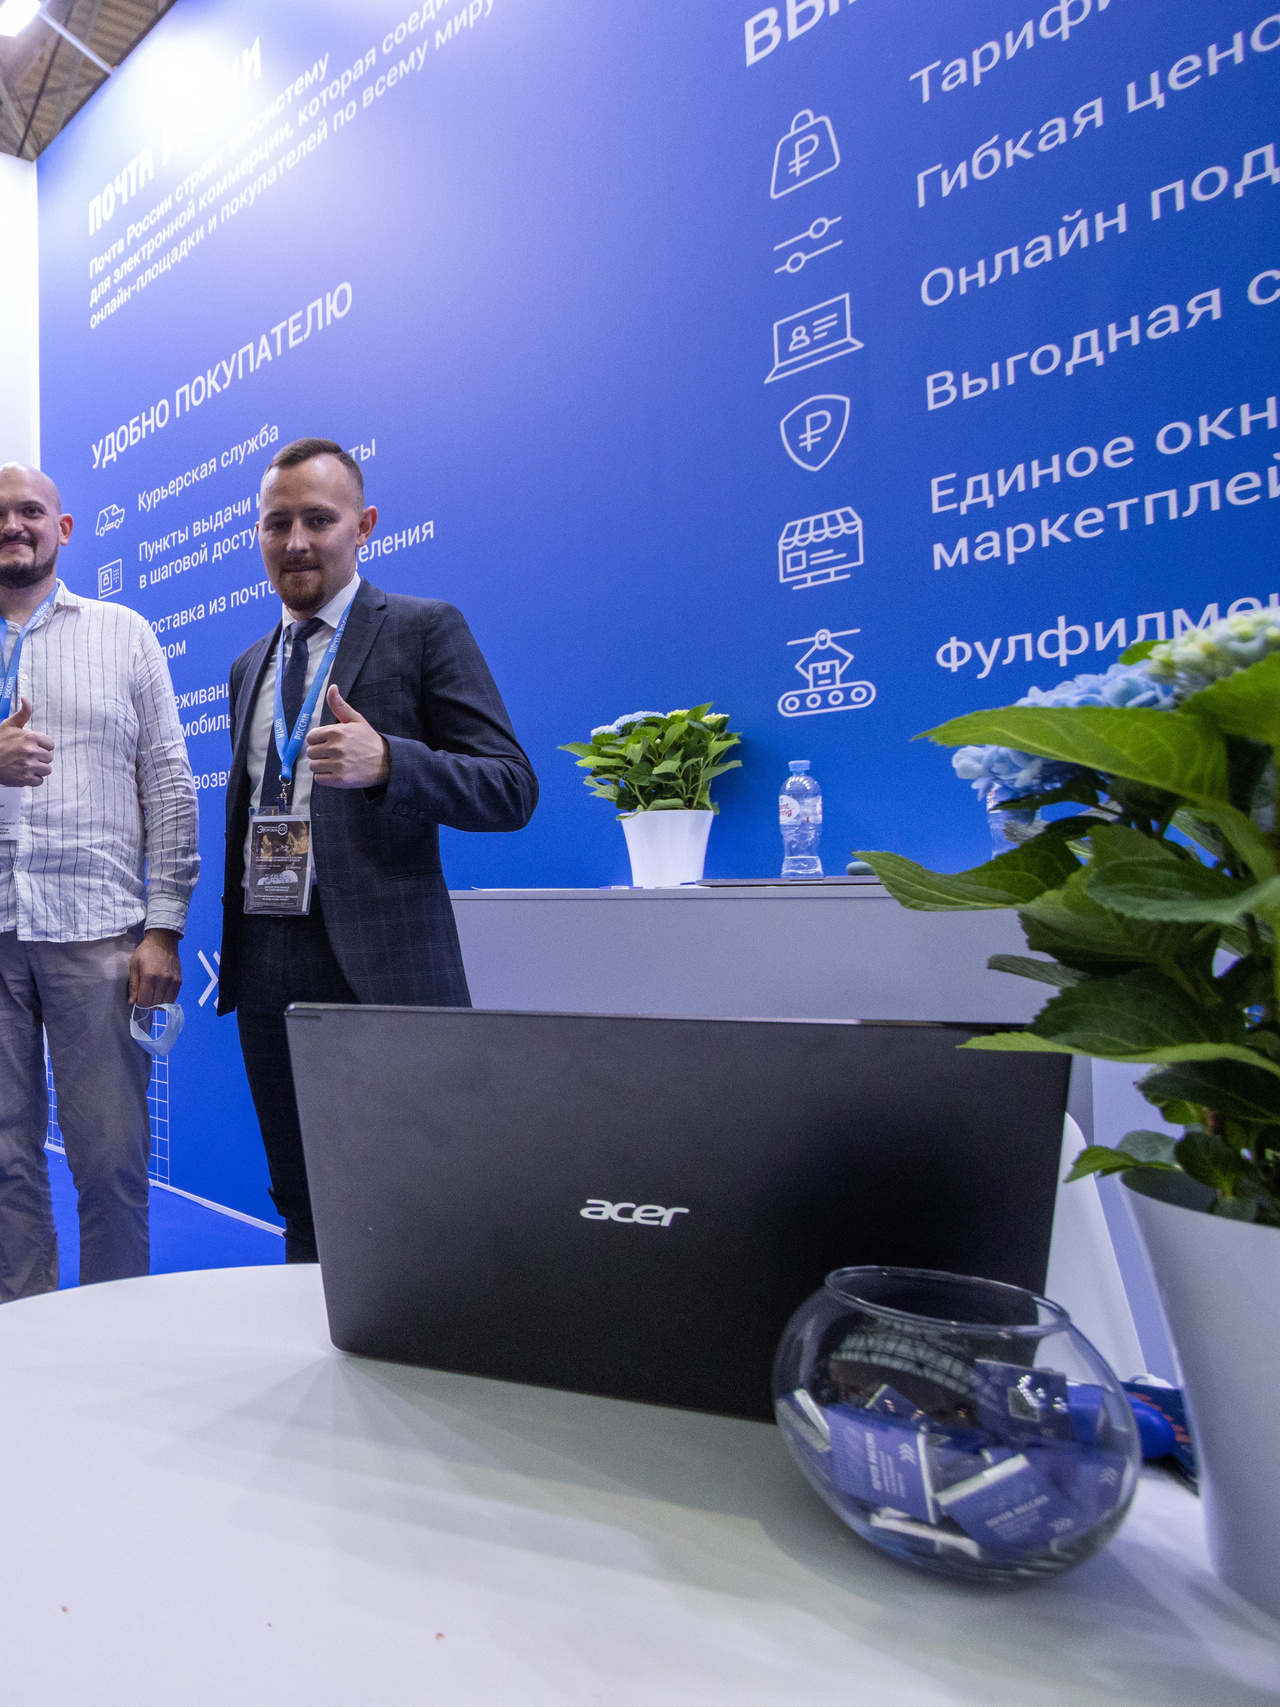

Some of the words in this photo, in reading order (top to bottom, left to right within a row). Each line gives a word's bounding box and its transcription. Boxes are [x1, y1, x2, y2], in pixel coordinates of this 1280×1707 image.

[744, 0, 858, 68] ВЫ
[909, 0, 1111, 104] Тариф
[88, 146, 154, 237] ПОЧТА
[162, 34, 261, 167] РОИИ
[918, 97, 1105, 208] Гибкая
[1127, 13, 1280, 113] цено
[89, 237, 125, 279] Почта
[127, 193, 172, 246] России
[175, 146, 225, 202] строит
[228, 52, 329, 157] экосистему
[89, 276, 111, 308] для
[113, 198, 195, 284] электронной
[199, 121, 293, 212] коммерции,
[298, 46, 376, 128] которая
[89, 224, 204, 329] онлайн-площадки
[208, 213, 217, 235] и
[221, 117, 328, 224] покупателей
[333, 100, 357, 133] по
[362, 39, 428, 109] всему
[921, 203, 1128, 307] Онлайн
[1151, 143, 1280, 221] под
[91, 399, 169, 469] УДОБНО
[175, 282, 353, 418] ПОКУПАТЕЛЮ
[926, 288, 1222, 411] Выгодная
[1247, 269, 1280, 306] с
[138, 457, 217, 512] Курьерская
[221, 424, 279, 468] служба
[931, 435, 1135, 515] Единое
[1155, 396, 1280, 456] окн
[139, 526, 189, 562] Пункты
[193, 497, 251, 537] выдачи
[139, 574, 147, 589] в
[150, 542, 208, 585] шаговой
[148, 604, 205, 635] оставка
[209, 596, 226, 615] из
[356, 520, 434, 567] еления
[4, 676, 14, 698] РОССИИ
[275, 717, 285, 739] ПОЧТА
[294, 713, 310, 741] РОССИИ
[193, 770, 231, 790] возв
[579, 1198, 690, 1227] acer
